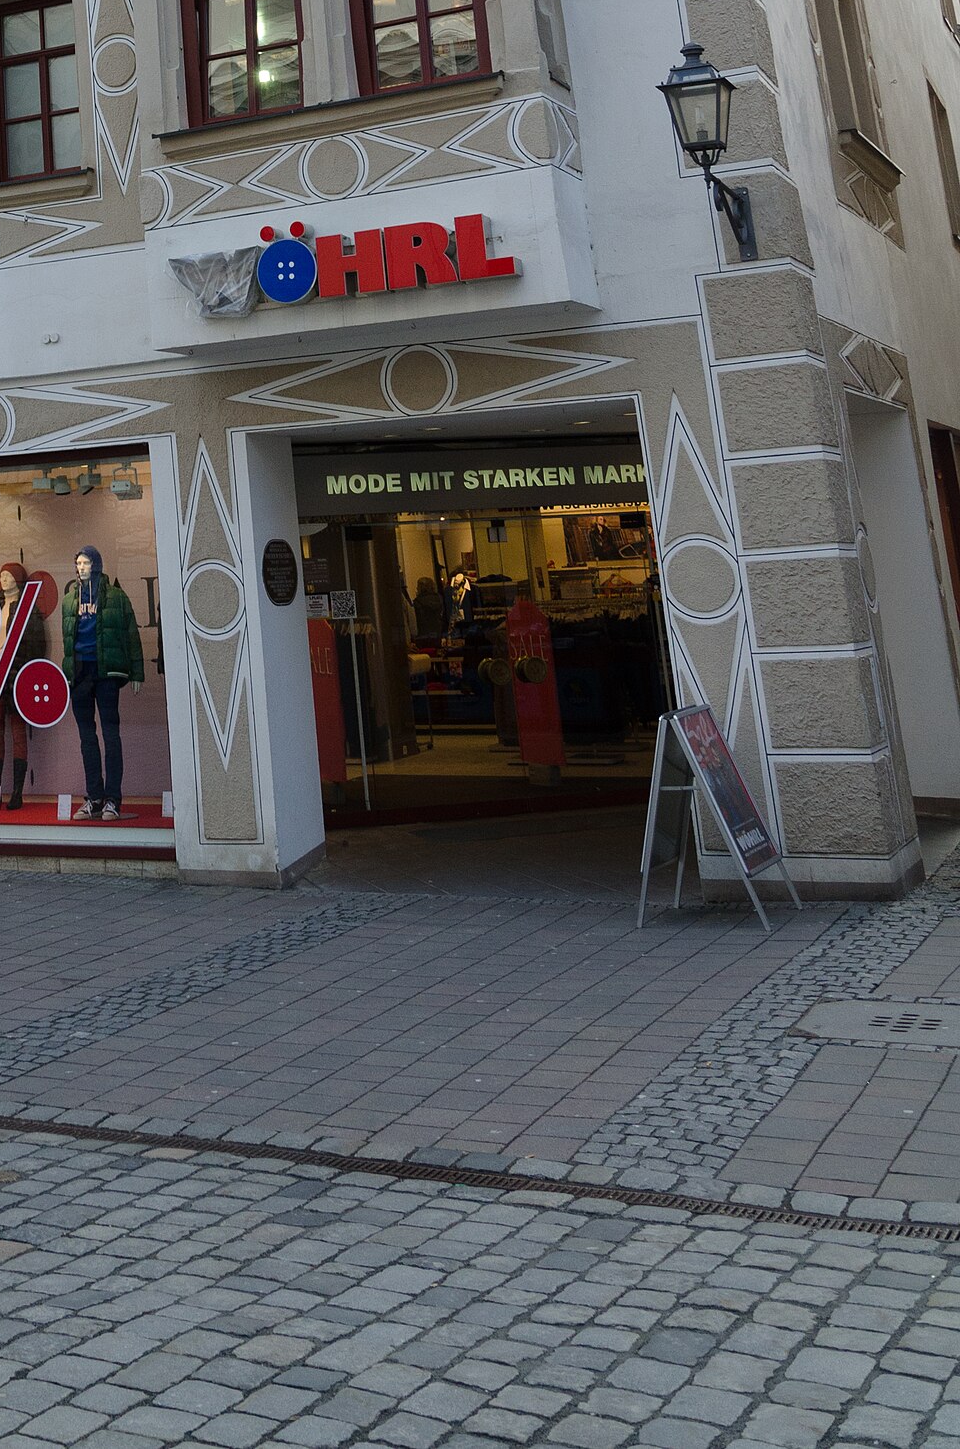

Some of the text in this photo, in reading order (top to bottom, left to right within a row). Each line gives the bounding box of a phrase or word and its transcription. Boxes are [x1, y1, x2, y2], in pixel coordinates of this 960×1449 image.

[325, 473, 403, 496] MODE
[410, 470, 455, 493] MIT
[463, 466, 576, 490] STARKEN
[504, 632, 549, 662] SALE
